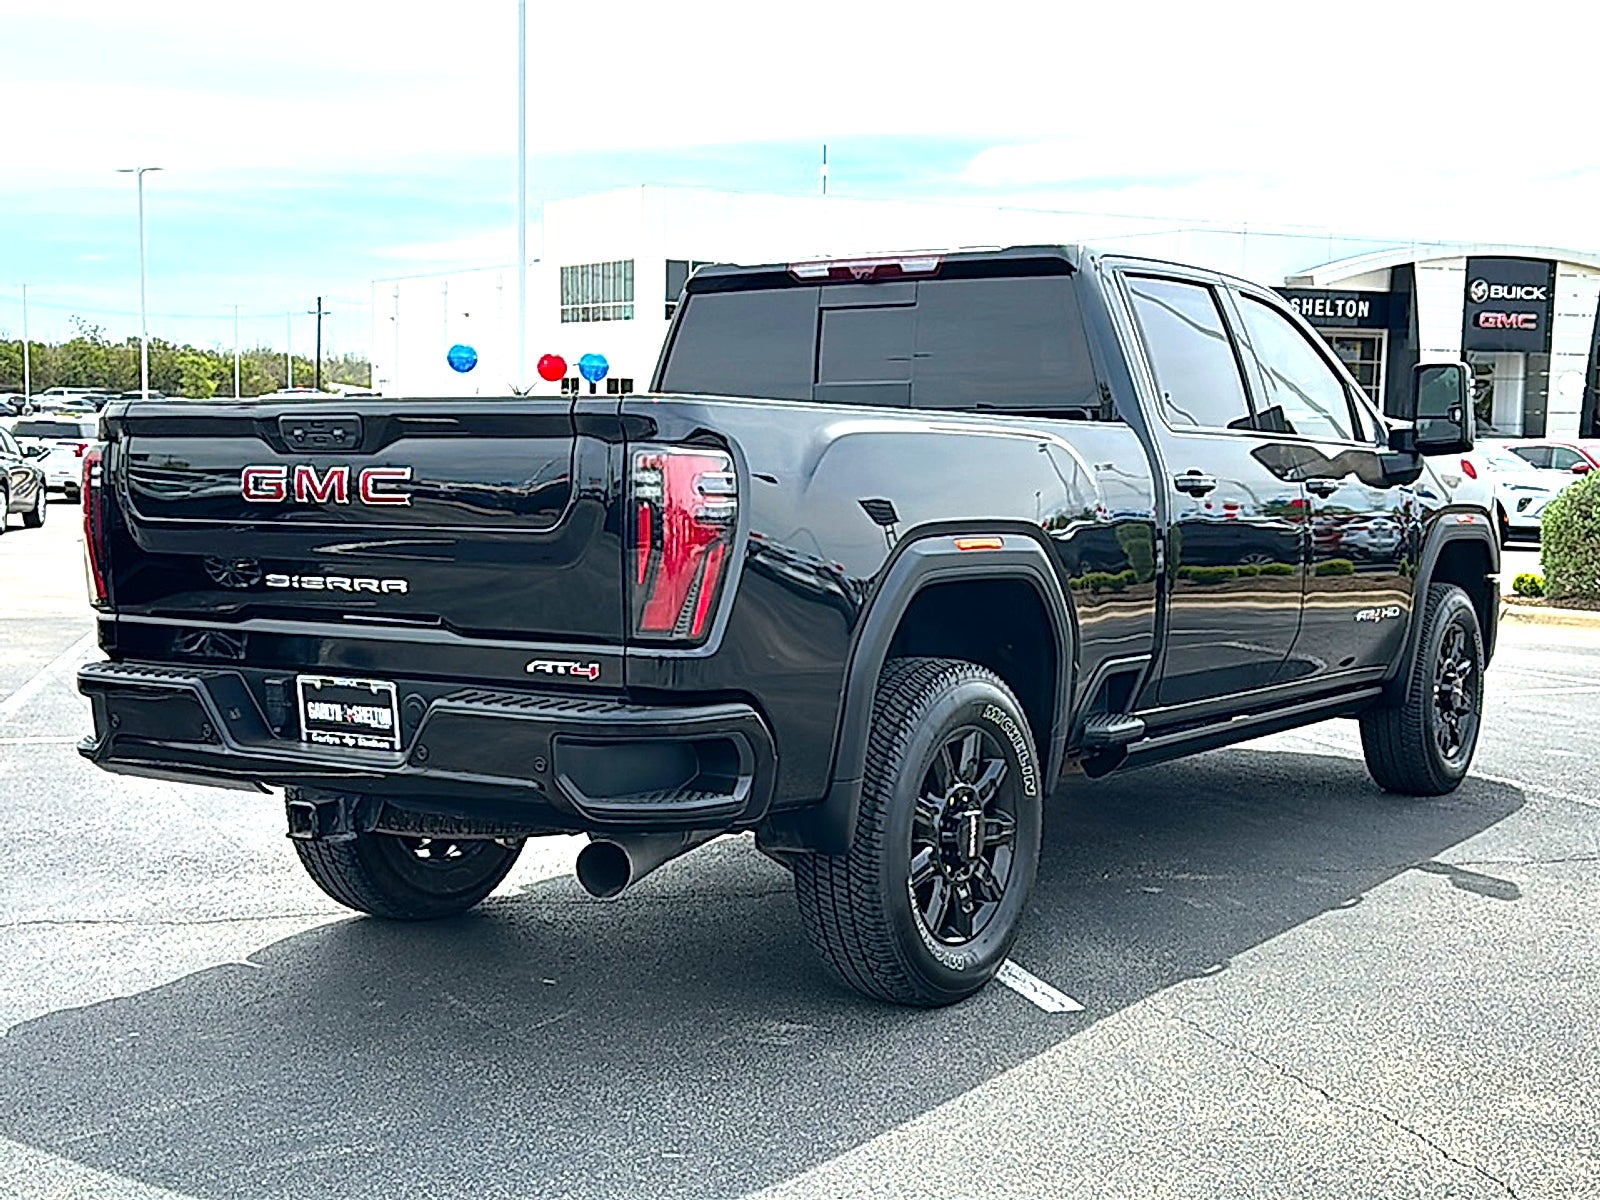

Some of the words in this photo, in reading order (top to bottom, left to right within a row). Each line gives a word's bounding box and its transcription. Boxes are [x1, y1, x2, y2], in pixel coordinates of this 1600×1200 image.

[1489, 284, 1548, 300] BUICK
[1290, 297, 1370, 317] SHELTON
[1479, 311, 1538, 330] GMC
[241, 465, 412, 506] GMC
[265, 574, 408, 593] SIERRA
[1381, 606, 1400, 618] HD
[526, 660, 600, 681] AT4
[982, 704, 1037, 796] MICHELIN
